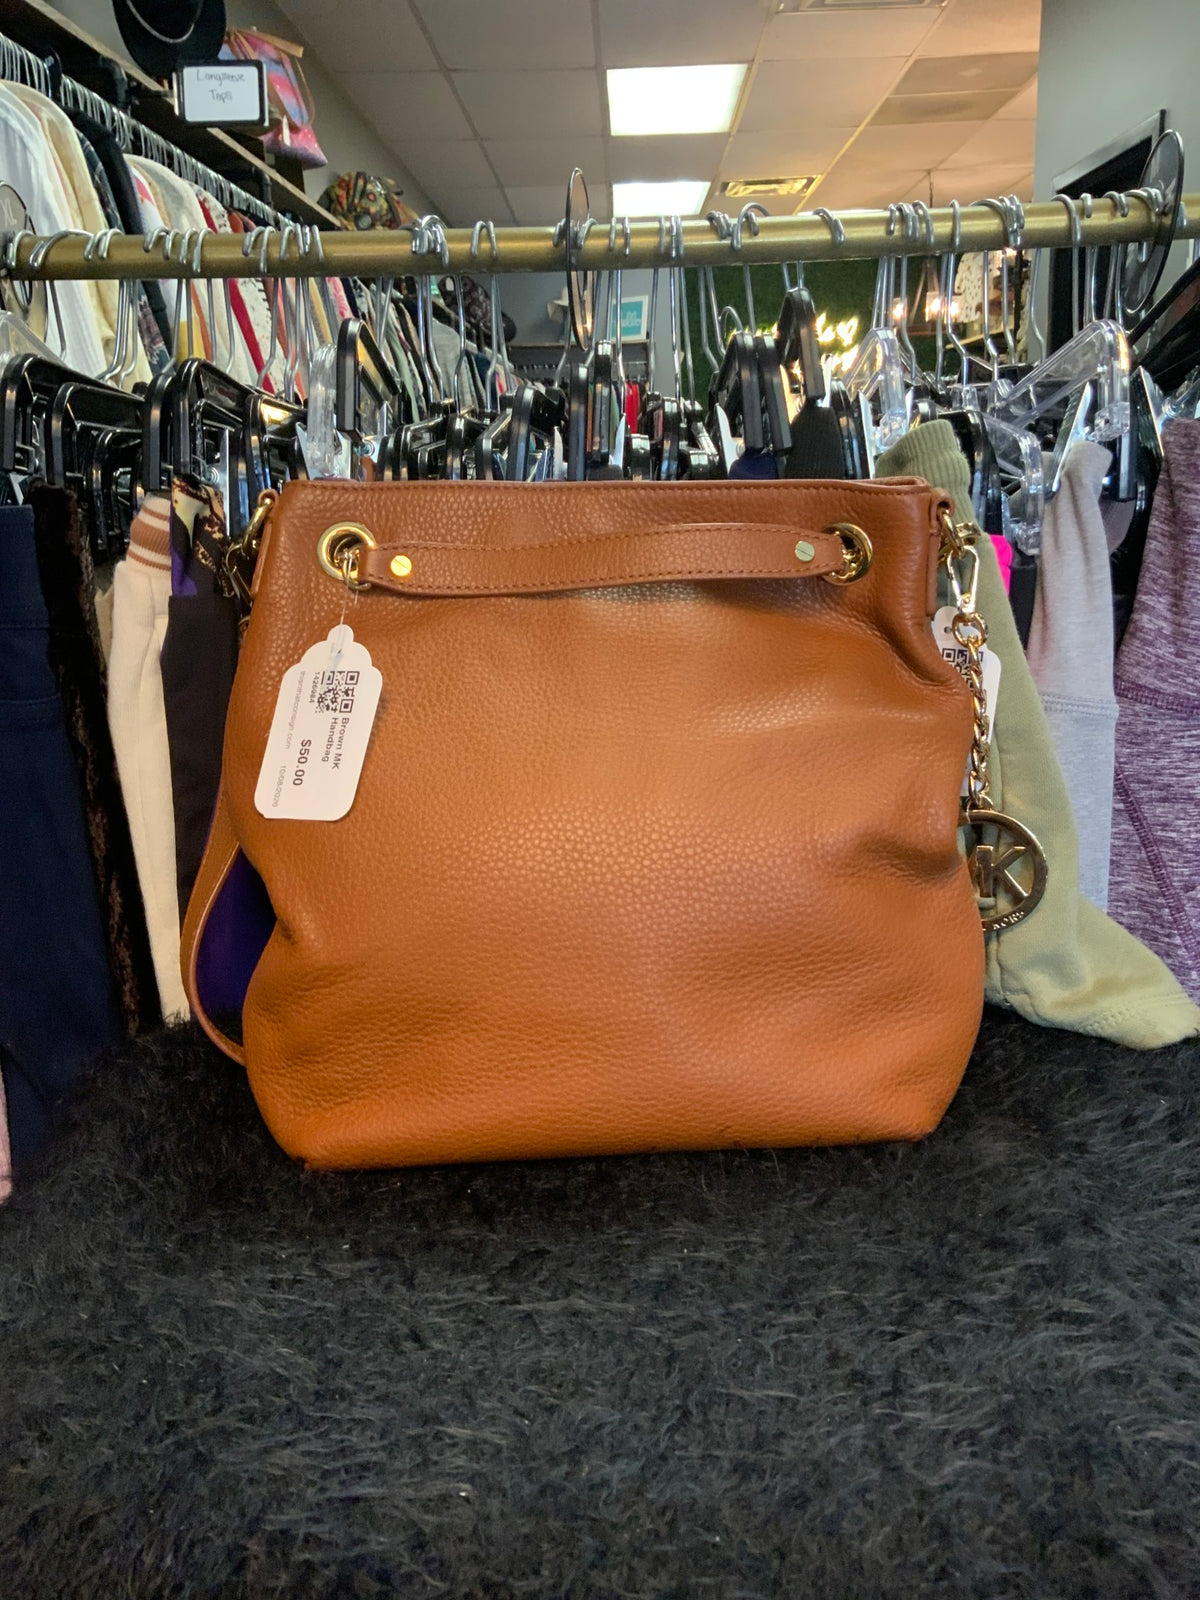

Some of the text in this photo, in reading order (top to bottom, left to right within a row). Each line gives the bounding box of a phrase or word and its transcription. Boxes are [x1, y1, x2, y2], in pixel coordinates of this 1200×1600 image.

[208, 88, 233, 104] Tops
[292, 739, 312, 786] $50.00
[321, 717, 339, 763] Handbag
[331, 717, 350, 770] Brown MK
